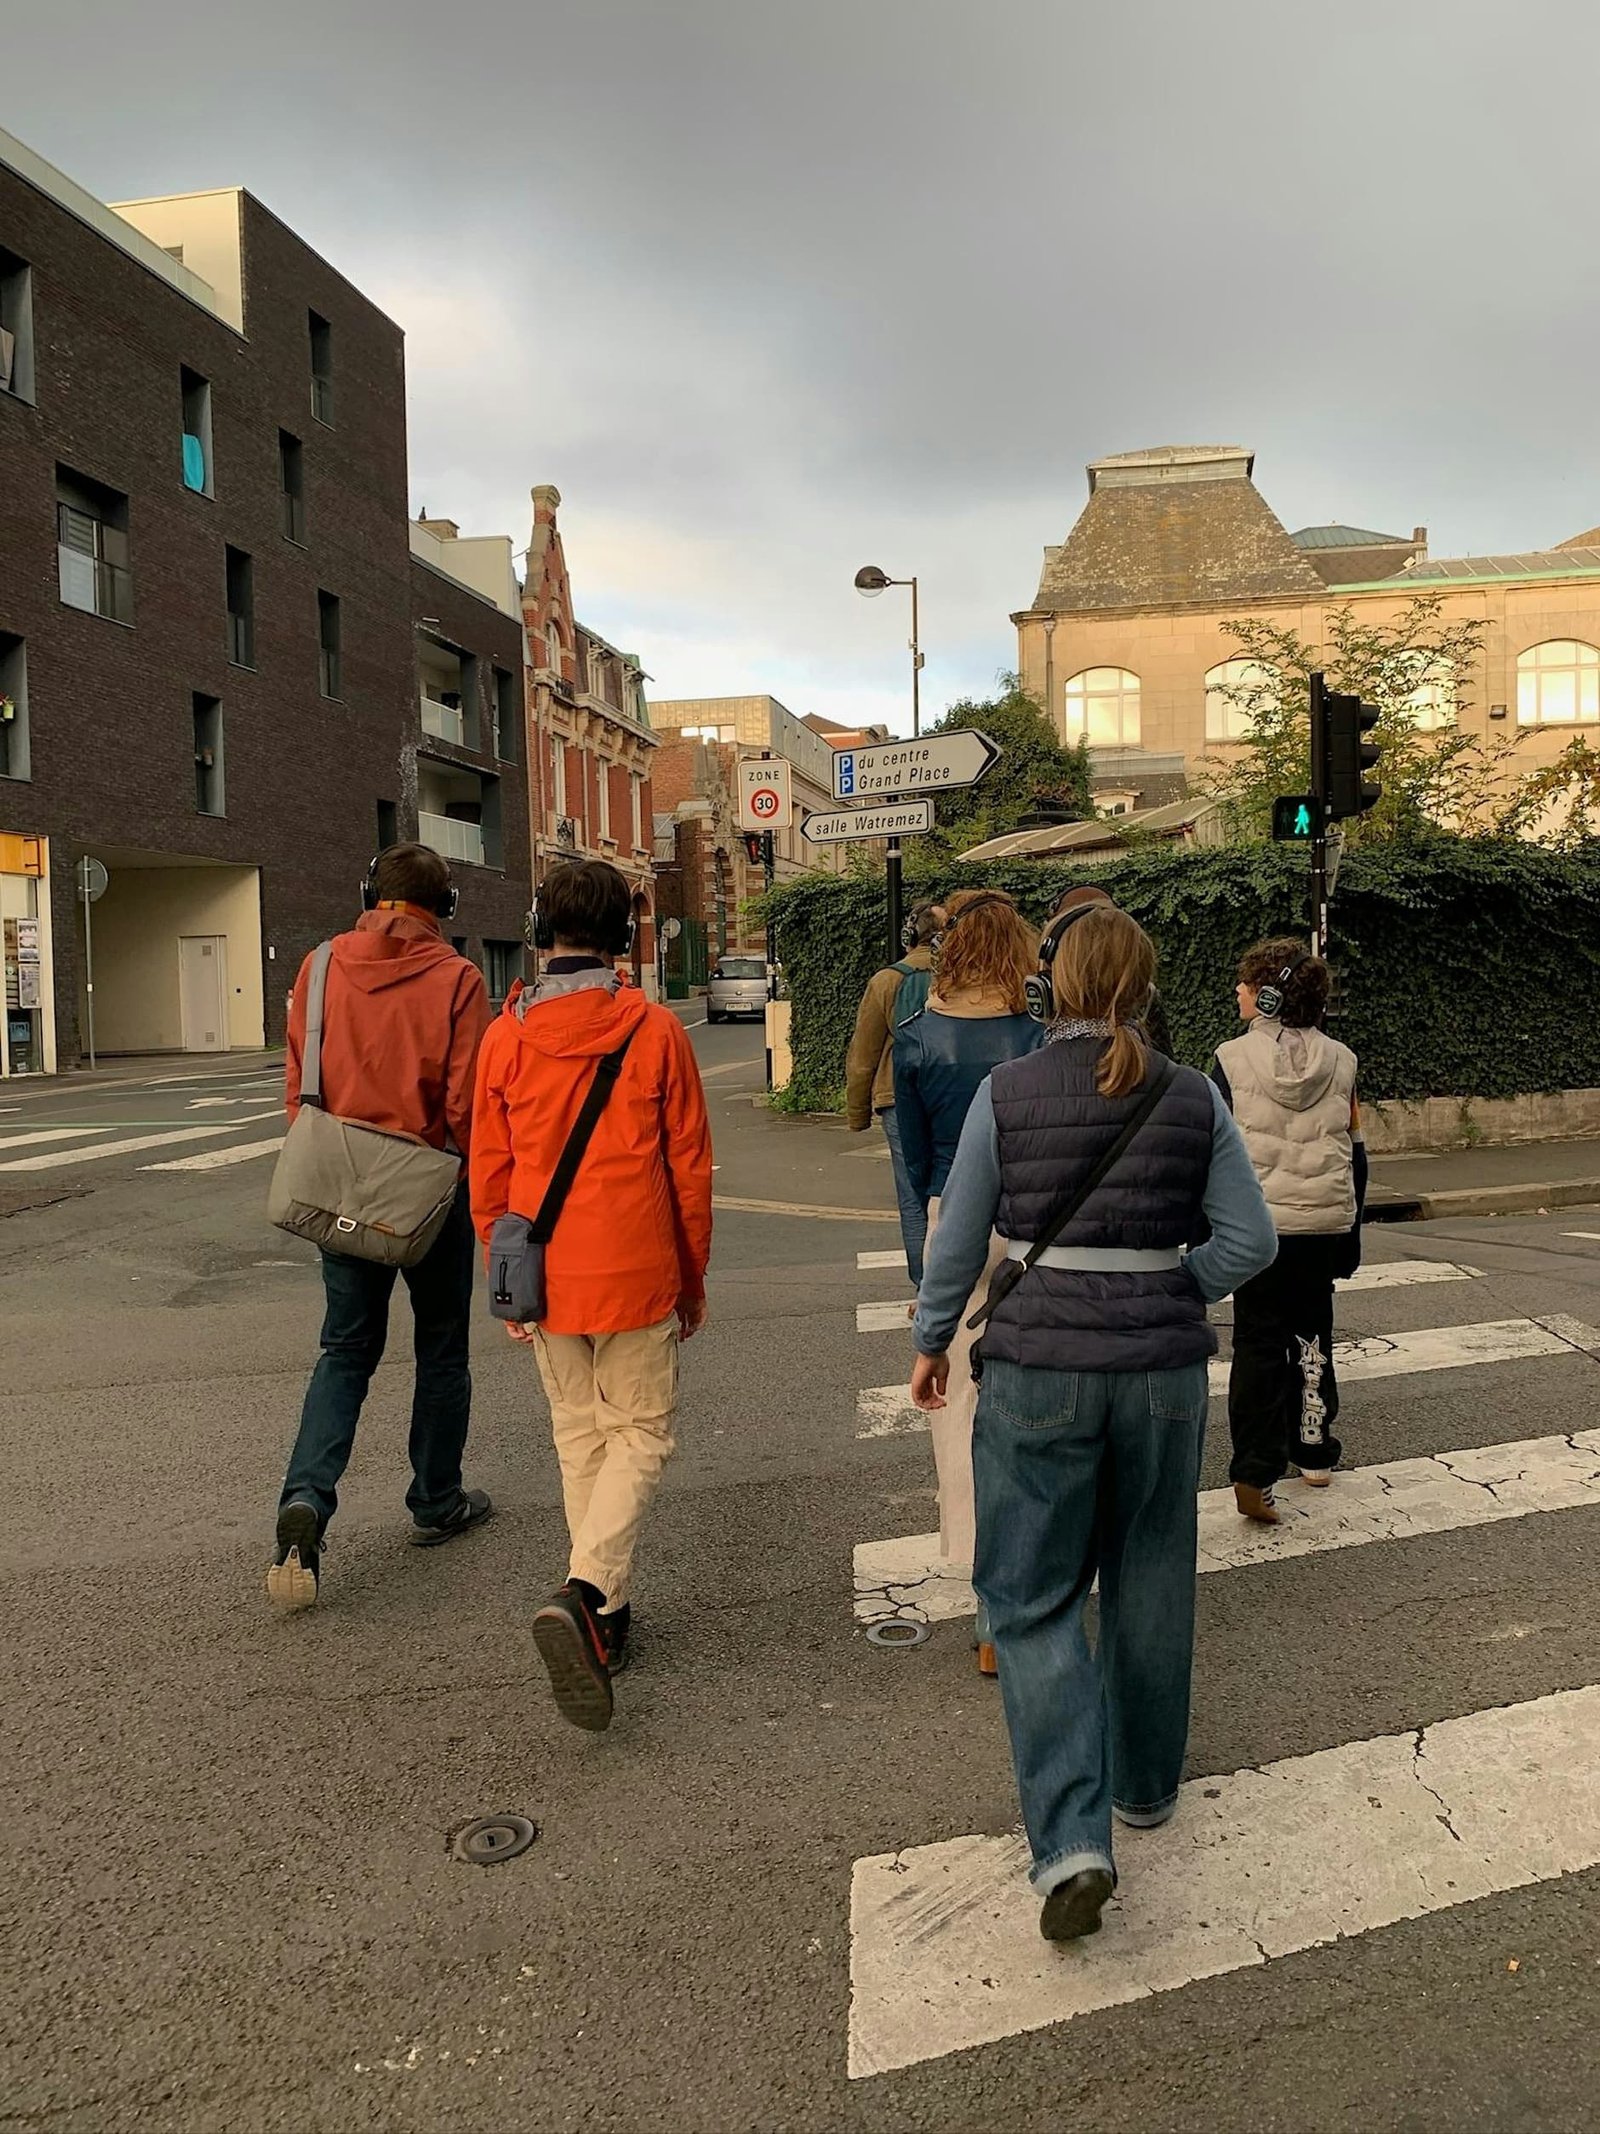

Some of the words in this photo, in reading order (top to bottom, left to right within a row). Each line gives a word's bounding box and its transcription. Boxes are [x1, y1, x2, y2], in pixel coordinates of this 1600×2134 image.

[841, 757, 851, 773] P
[859, 755, 874, 770] du
[883, 749, 930, 767] centre
[748, 770, 780, 781] ZONE
[841, 776, 851, 792] P
[859, 770, 901, 790] Grand
[909, 766, 950, 783] Place
[756, 797, 774, 810] 30
[815, 819, 848, 835] salle
[855, 813, 923, 831] Watremez
